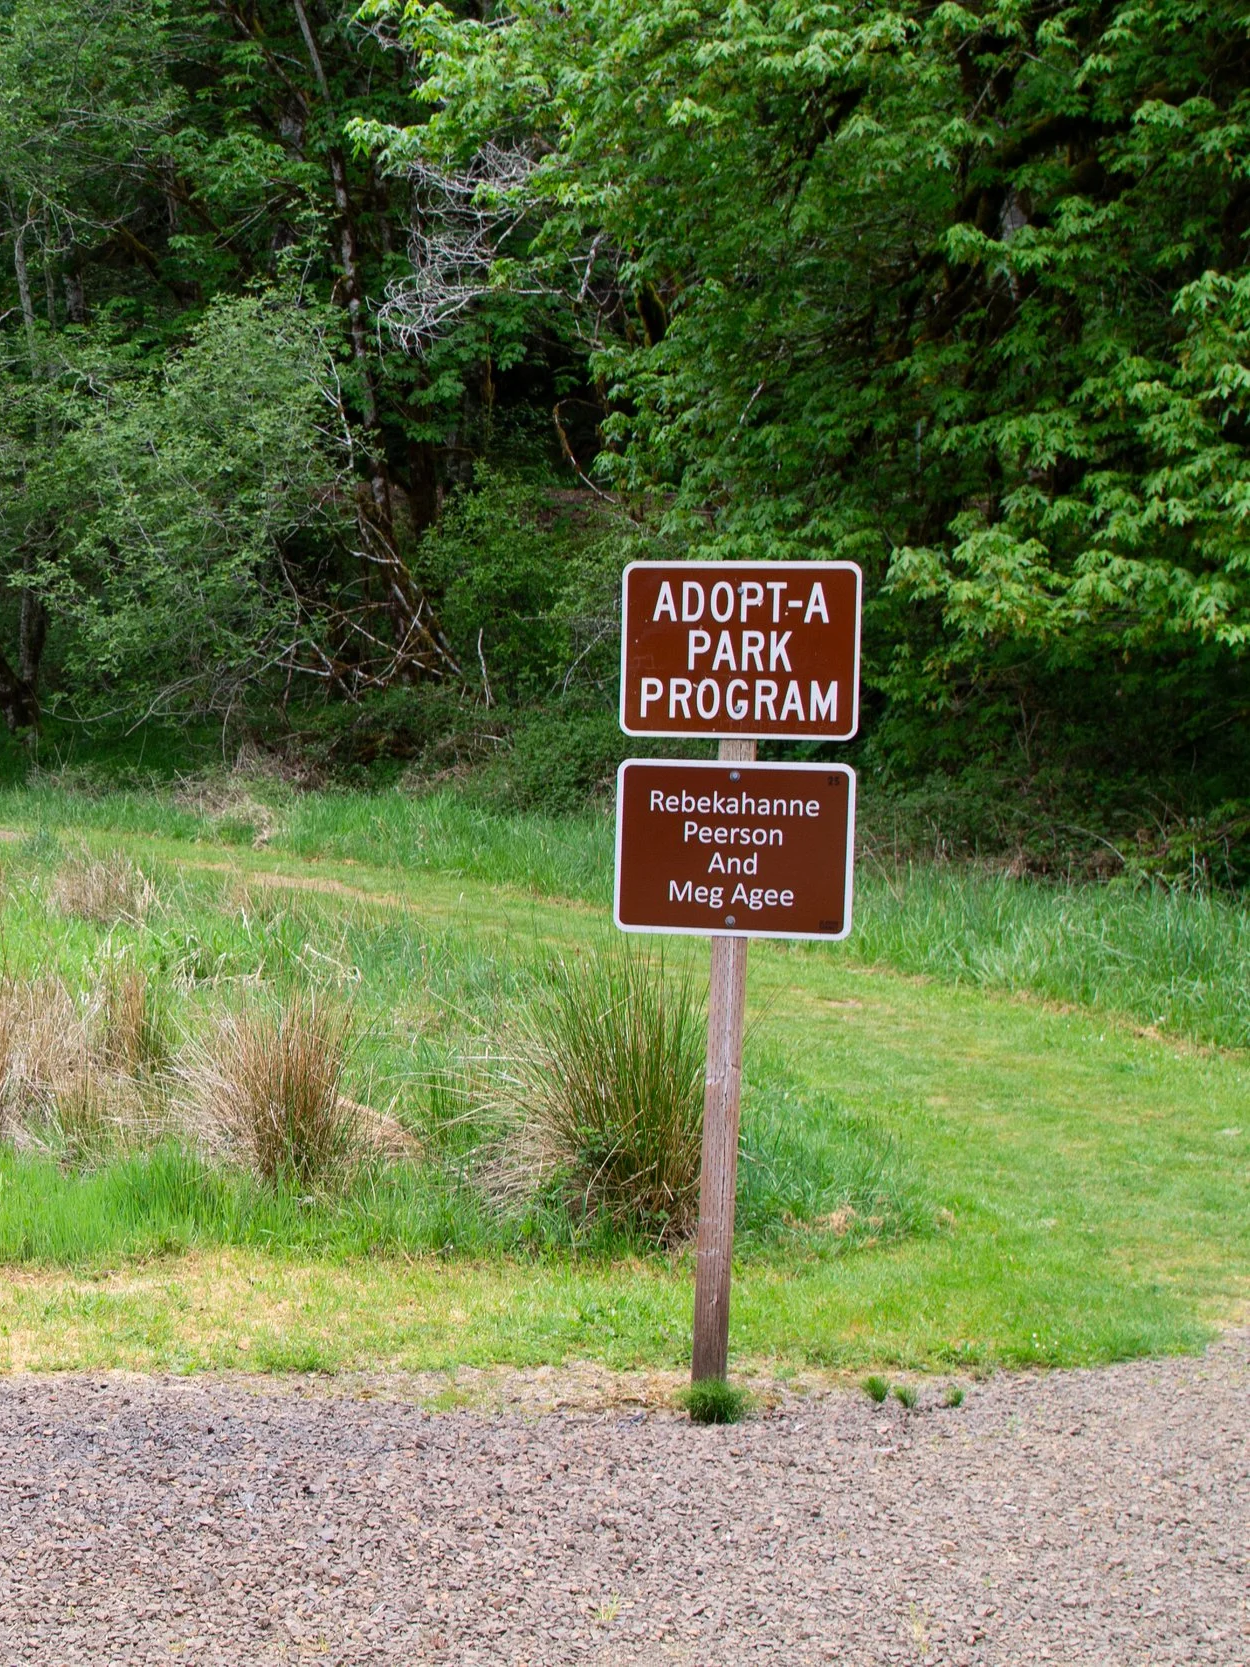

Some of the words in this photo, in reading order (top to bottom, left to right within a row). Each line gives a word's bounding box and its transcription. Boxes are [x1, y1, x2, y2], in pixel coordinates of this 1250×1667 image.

[652, 581, 829, 624] ADOPT-A
[687, 630, 792, 672] PARK
[640, 678, 838, 722] PROGRAM
[650, 790, 819, 818] Rebekahanne
[684, 821, 783, 846] Peerson
[708, 852, 758, 875] And
[669, 881, 724, 908] Meg
[730, 883, 794, 910] Agee
